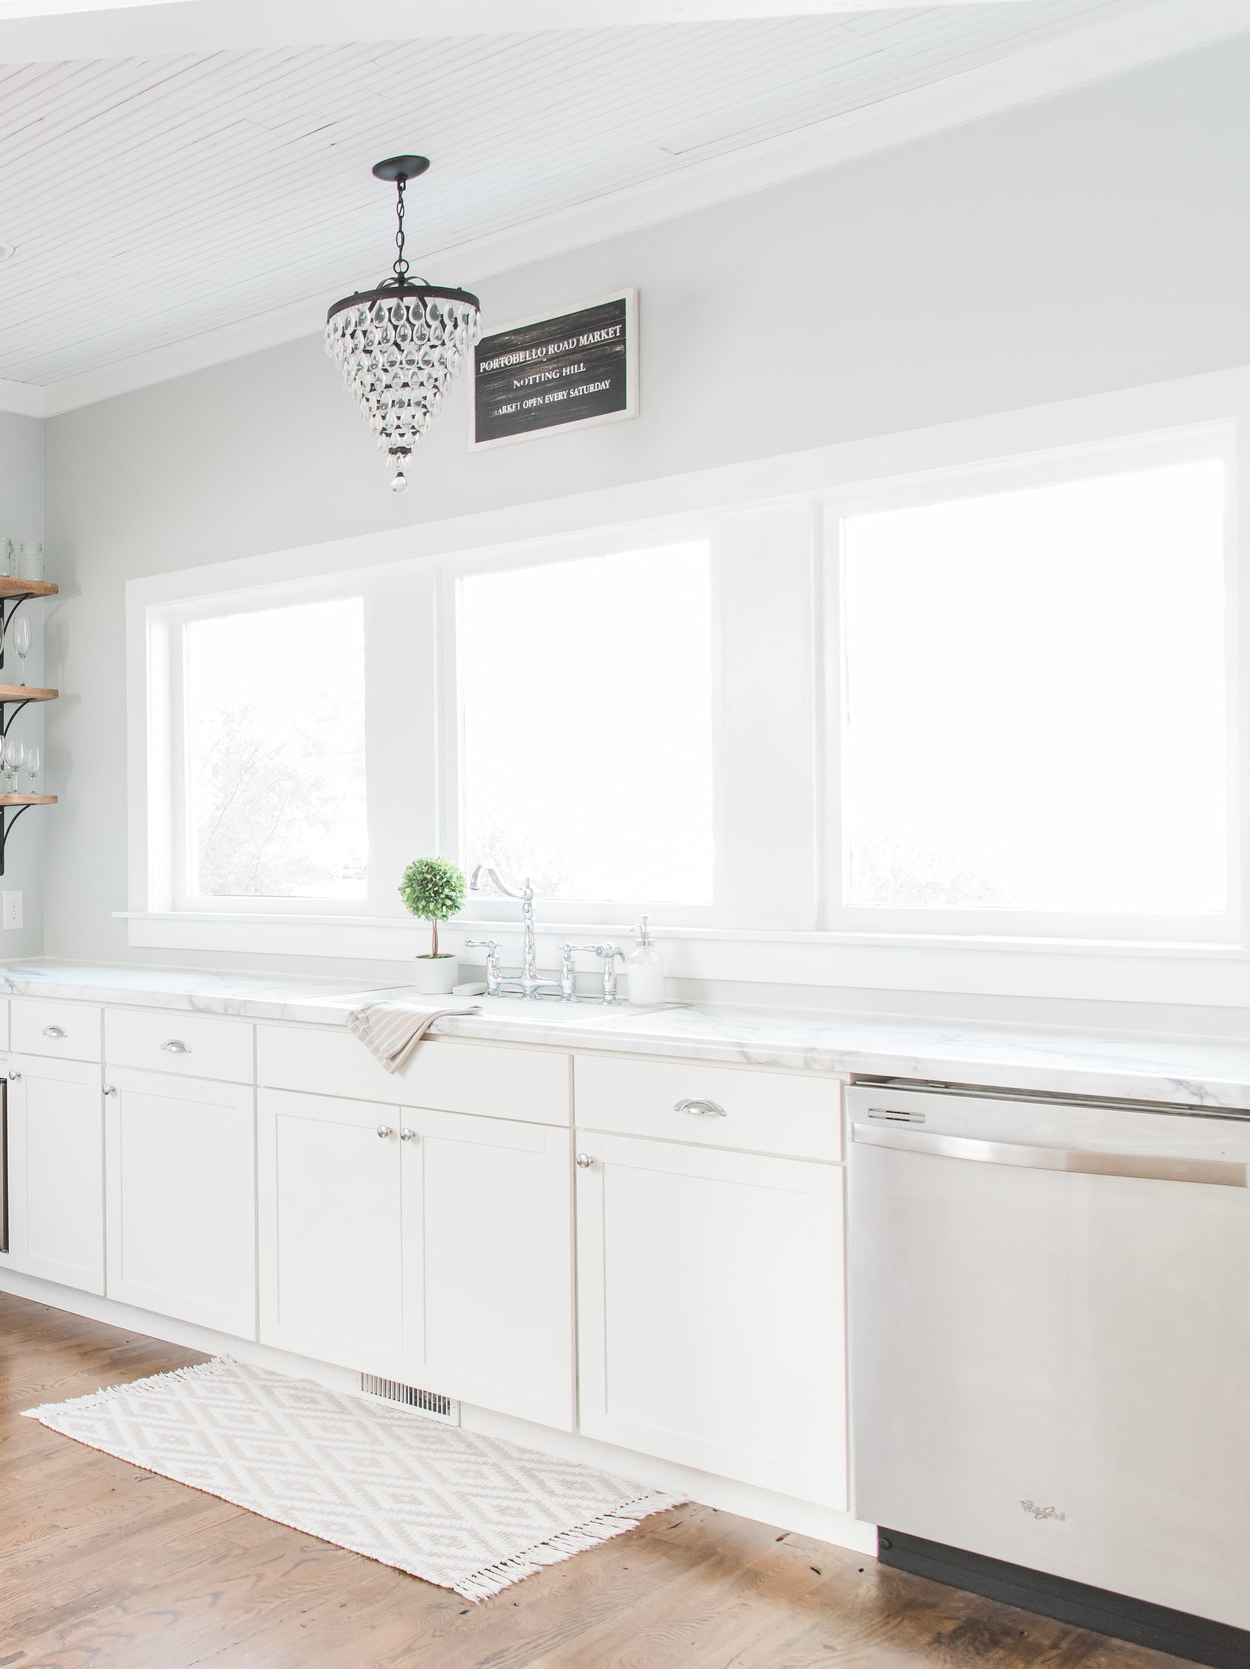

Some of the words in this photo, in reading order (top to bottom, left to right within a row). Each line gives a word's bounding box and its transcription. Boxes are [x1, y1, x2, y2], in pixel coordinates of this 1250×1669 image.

[479, 346, 547, 373] PORTOBELLO
[548, 338, 577, 355] ROAD
[579, 324, 623, 347] MARKET
[512, 369, 560, 389] NOTTING
[562, 362, 587, 377] HILL
[522, 395, 544, 409] OPEN
[545, 389, 569, 404] EVERY
[569, 379, 612, 398] SATURDAY
